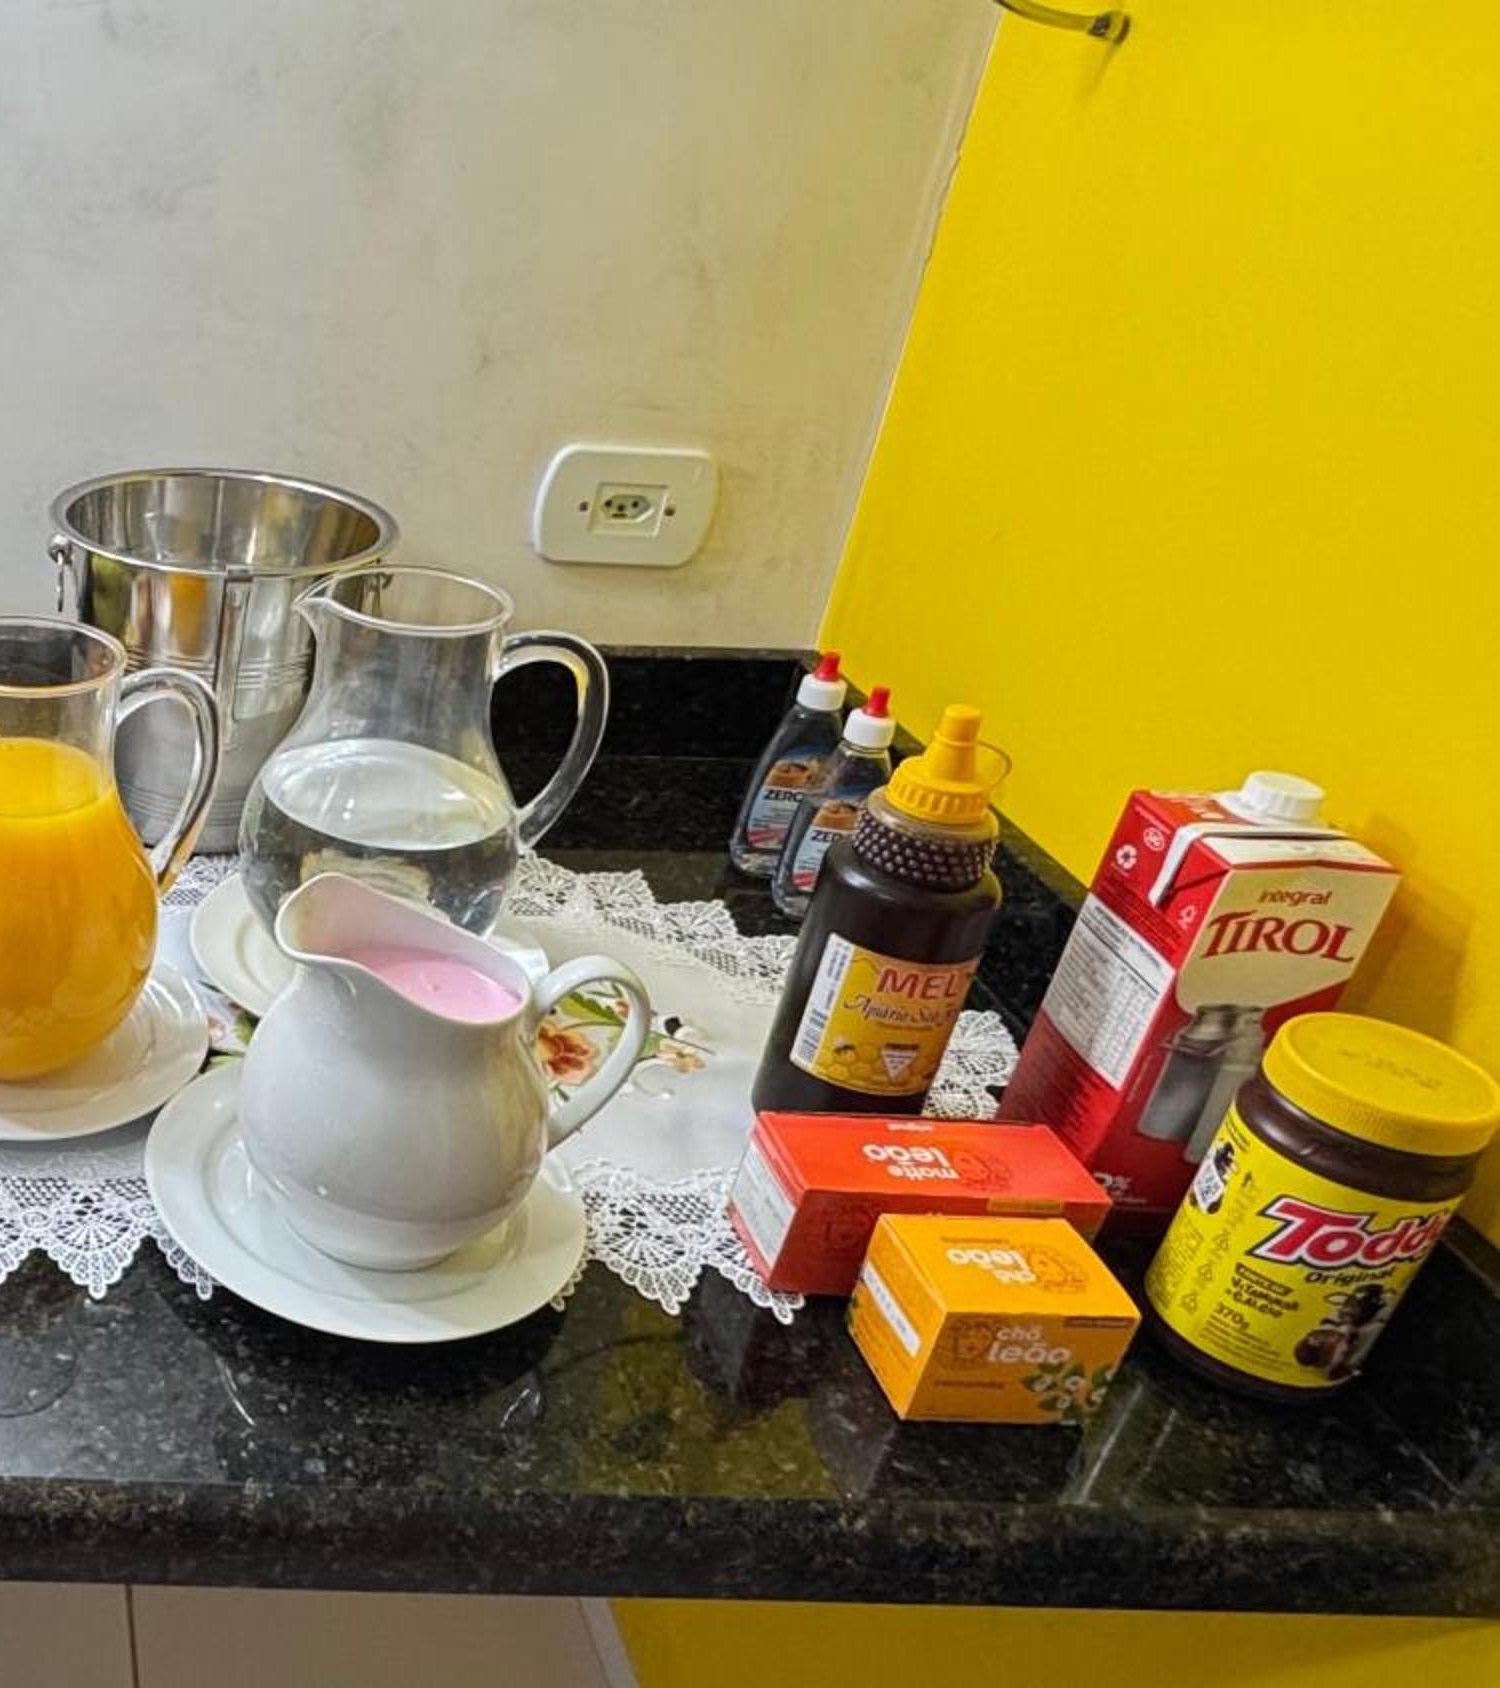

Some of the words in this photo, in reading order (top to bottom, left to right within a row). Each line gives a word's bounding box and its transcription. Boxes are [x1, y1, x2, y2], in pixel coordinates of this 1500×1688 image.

[811, 830, 841, 842] ZER
[1257, 891, 1332, 907] integral
[1201, 910, 1354, 962] TIROL
[878, 968, 960, 999] MEL
[861, 1143, 952, 1167] leão
[1250, 1196, 1450, 1268] Todd
[947, 1249, 1029, 1271] leão
[1306, 1267, 1396, 1285] Original
[987, 1341, 1072, 1364] leão
